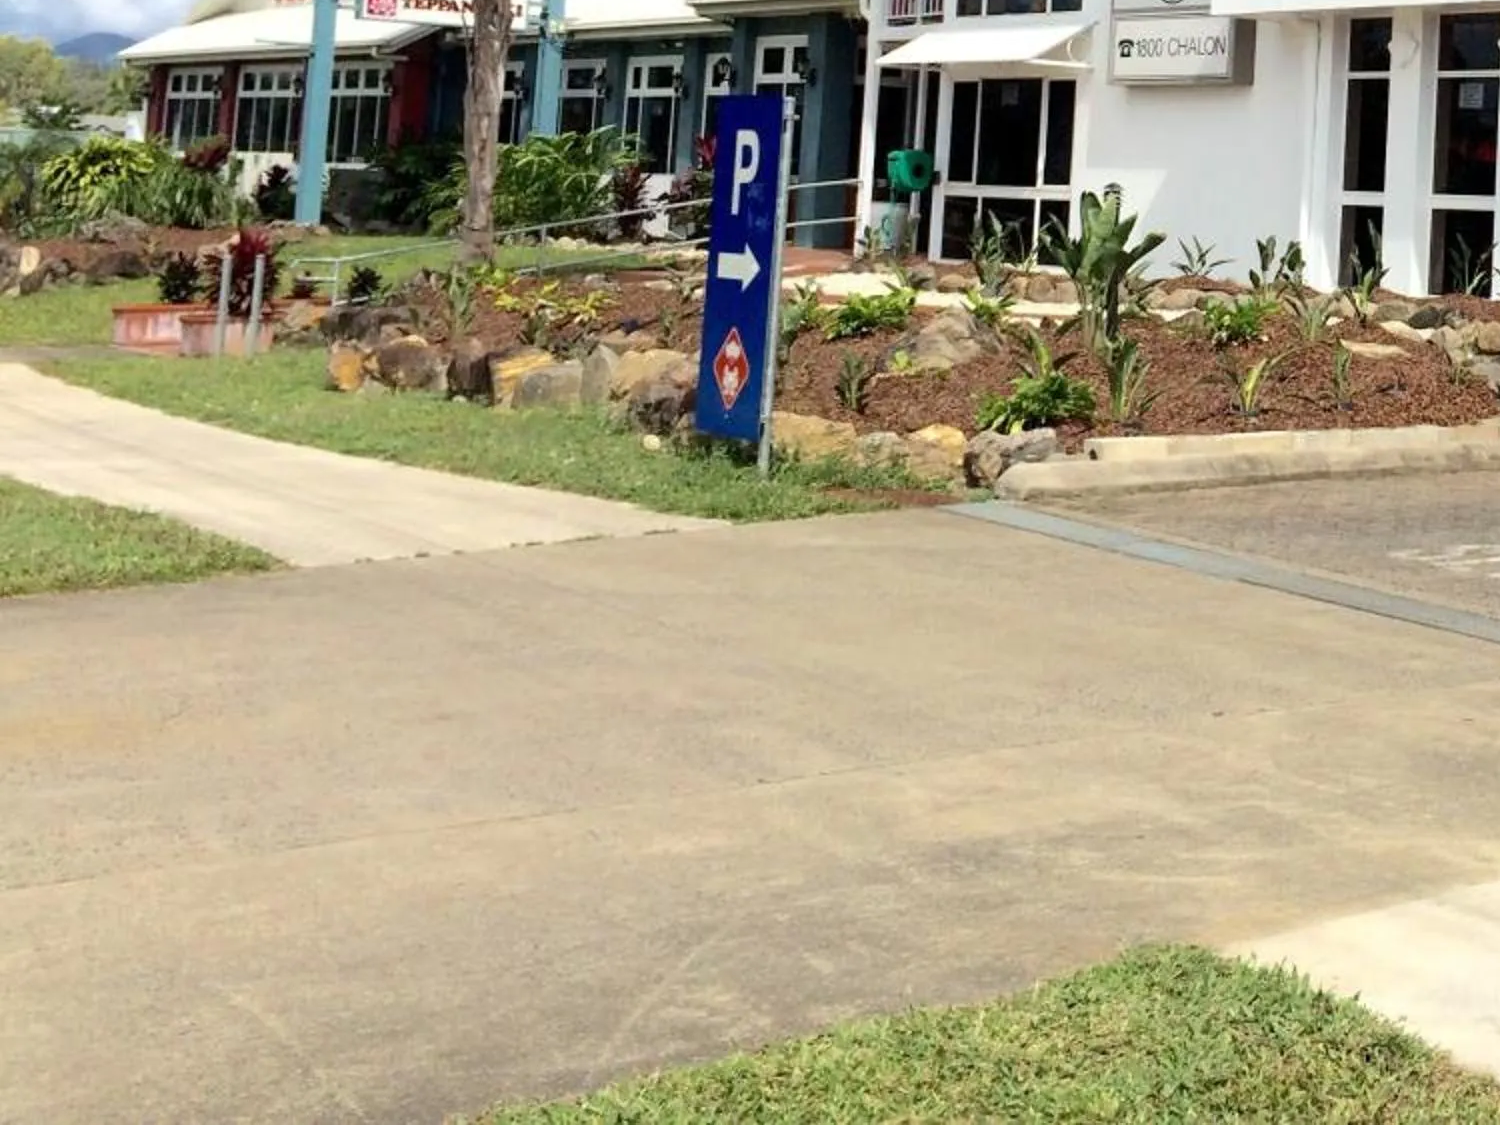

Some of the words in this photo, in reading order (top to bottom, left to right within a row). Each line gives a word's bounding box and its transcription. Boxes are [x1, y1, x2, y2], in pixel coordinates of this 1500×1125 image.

[1136, 38, 1163, 57] 1800
[1167, 36, 1226, 57] CHALON
[731, 129, 761, 216] P
